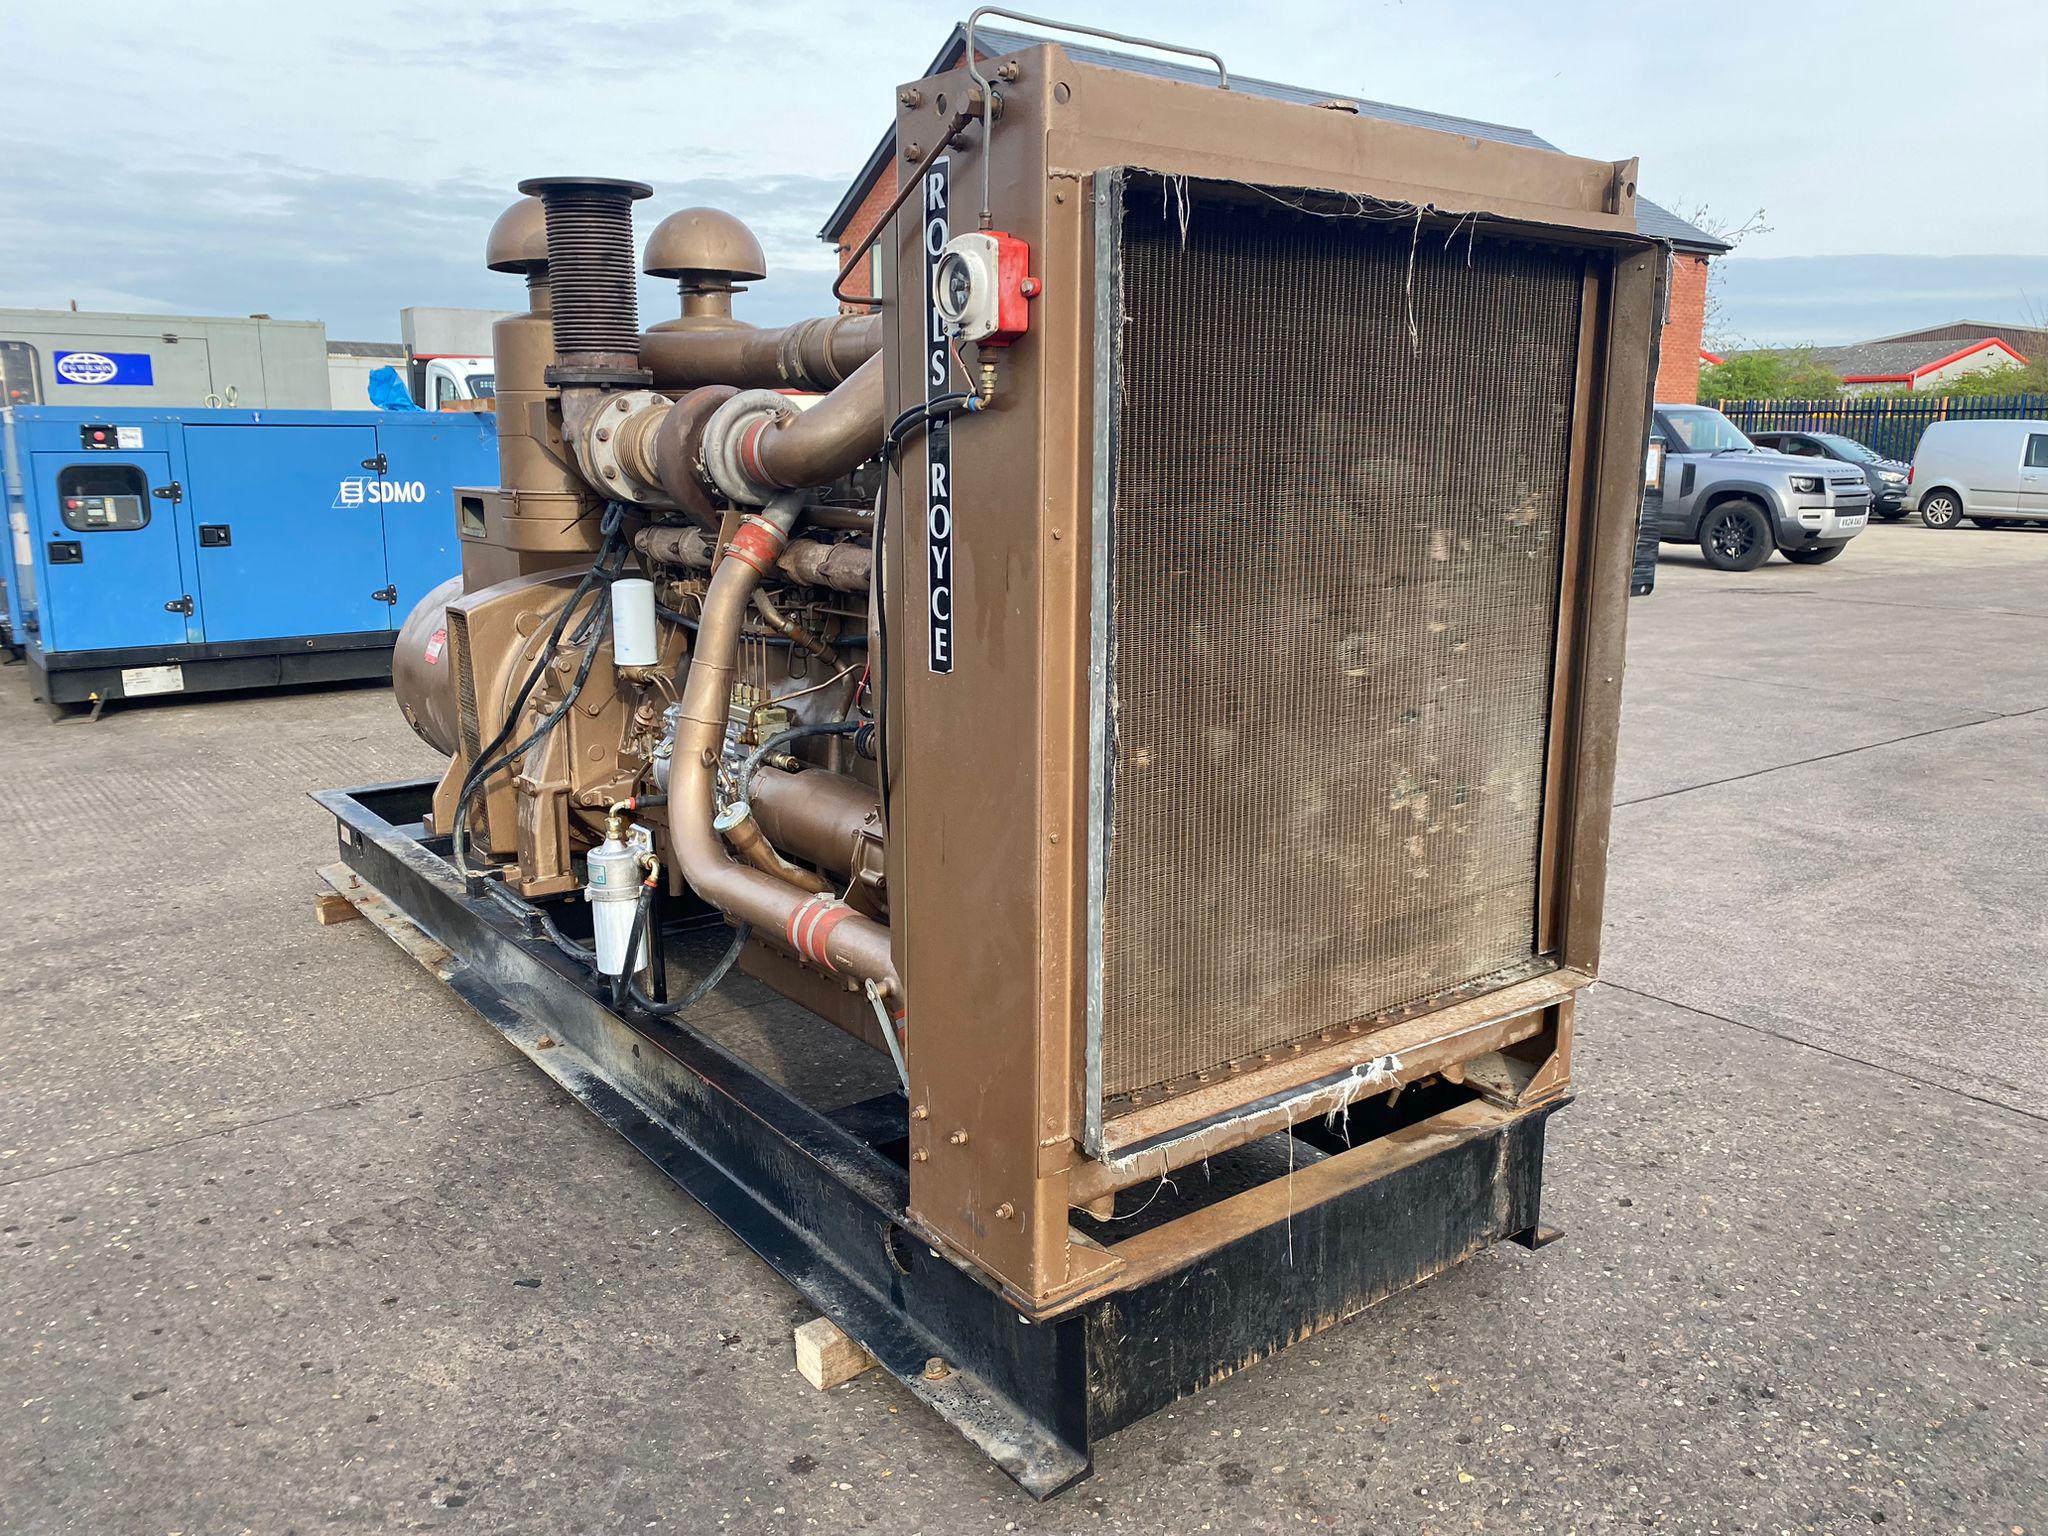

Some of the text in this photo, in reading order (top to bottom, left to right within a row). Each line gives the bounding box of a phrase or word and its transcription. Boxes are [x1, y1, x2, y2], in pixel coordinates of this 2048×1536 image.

[76, 363, 112, 373] WILSON
[926, 172, 950, 661] ROLS ROYCE
[367, 481, 426, 503] SDMO
